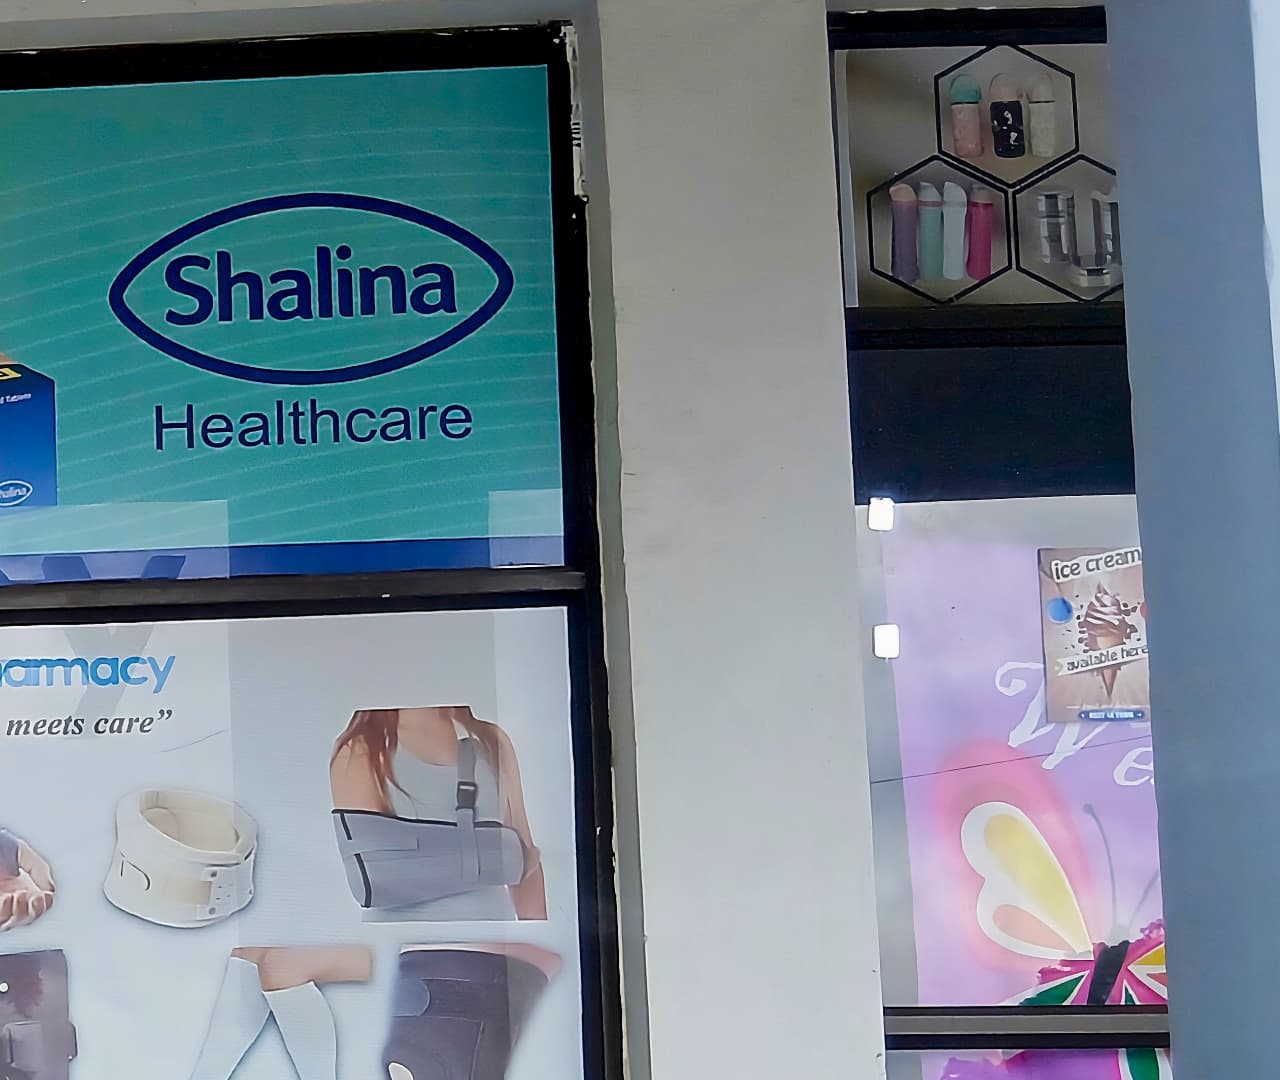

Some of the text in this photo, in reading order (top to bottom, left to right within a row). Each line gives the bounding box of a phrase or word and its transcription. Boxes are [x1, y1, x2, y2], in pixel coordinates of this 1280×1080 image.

[163, 244, 458, 327] Shalina
[154, 396, 474, 452] Healthcare
[1054, 548, 1141, 580] ice cream
[1066, 649, 1119, 672] available
[7, 711, 85, 738] meets
